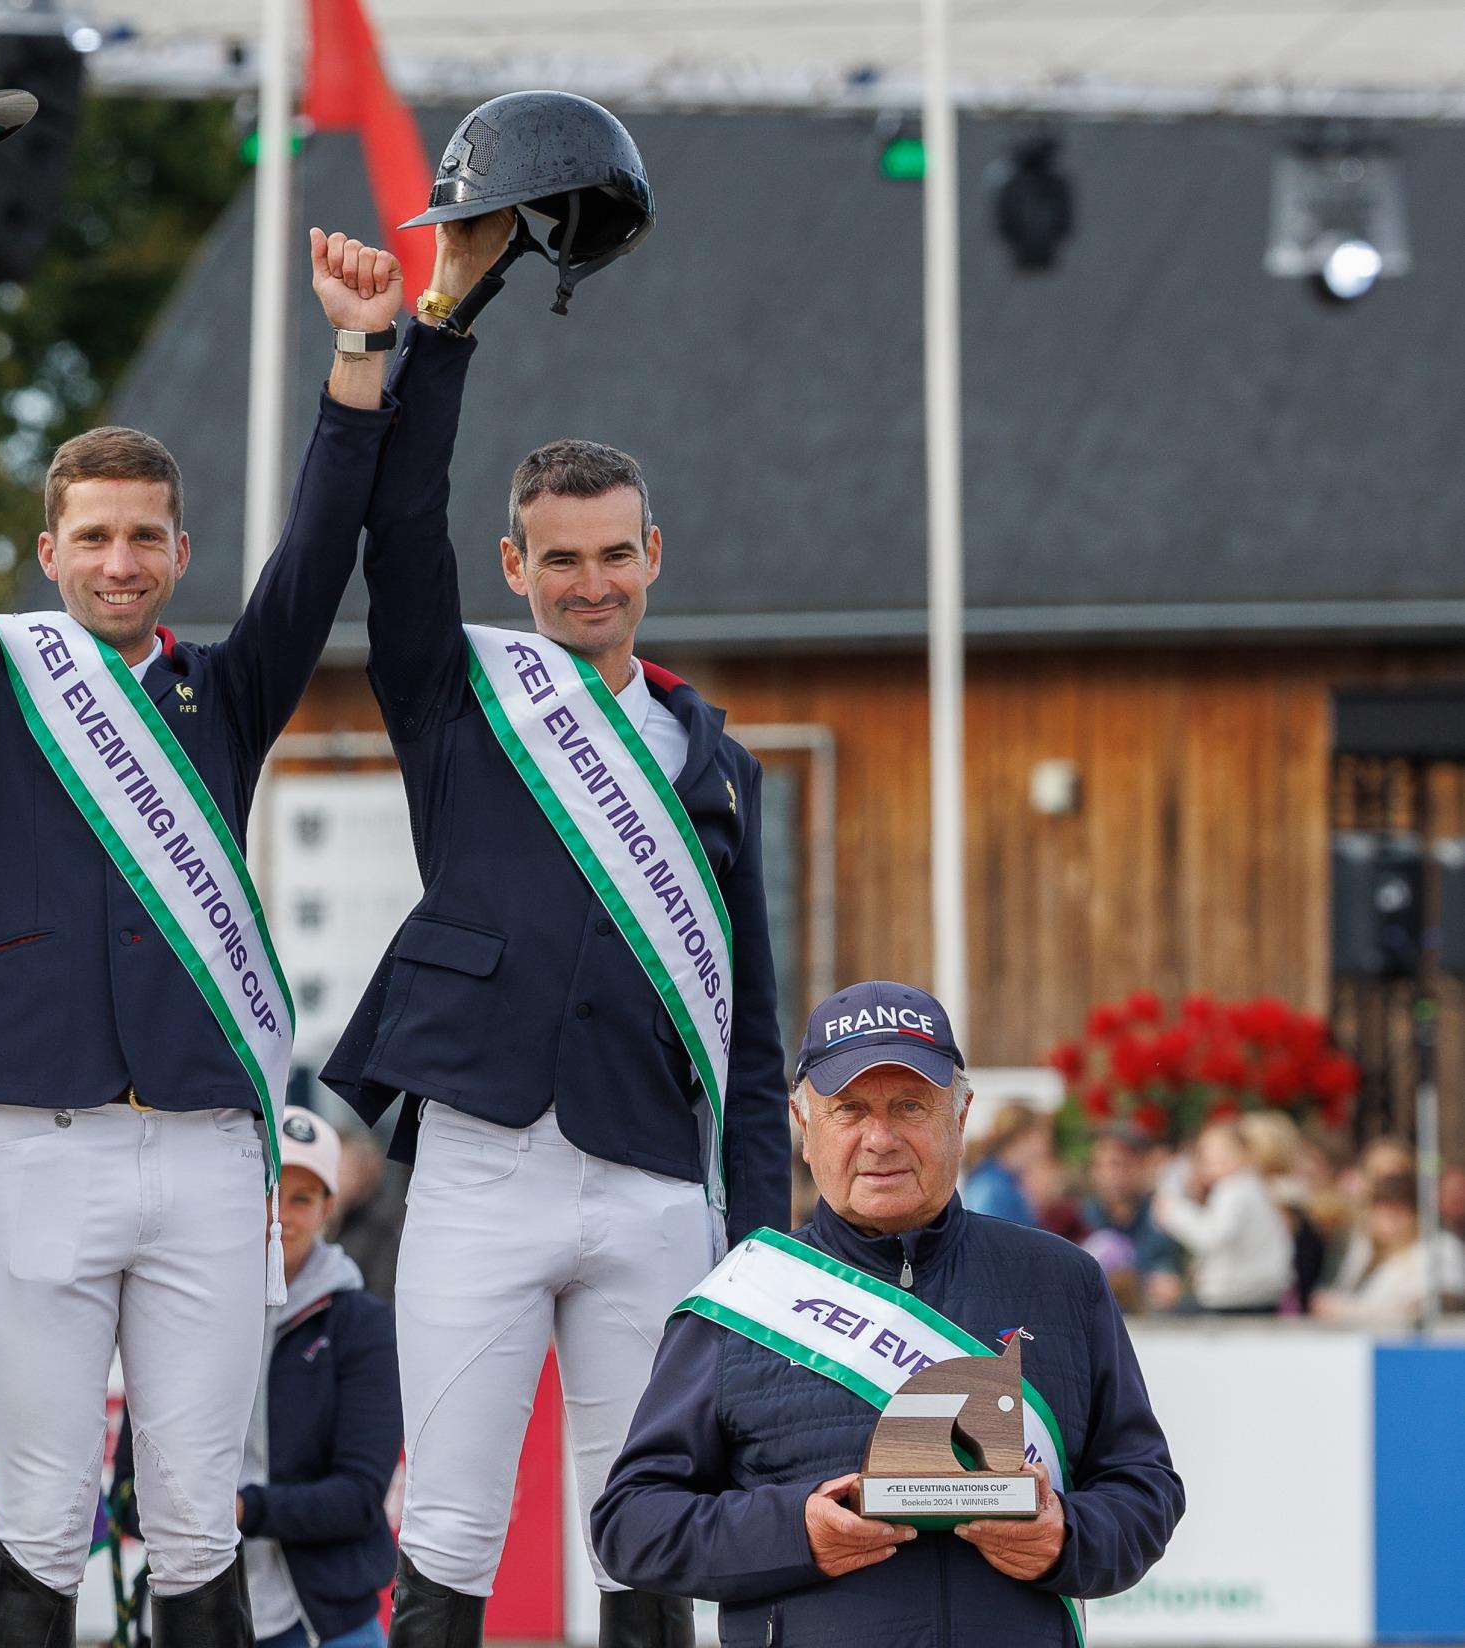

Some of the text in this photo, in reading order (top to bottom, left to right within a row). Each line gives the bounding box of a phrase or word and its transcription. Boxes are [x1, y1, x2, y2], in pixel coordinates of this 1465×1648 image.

[62, 680, 175, 839] EVENTING
[163, 832, 247, 972] NATIONS
[543, 706, 656, 864] EVENTING
[643, 859, 720, 999] NATIONS
[825, 1005, 934, 1041] FRANCE
[908, 1484, 951, 1492] EVENTING
[952, 1484, 989, 1492] NATIONS
[933, 1498, 953, 1506] 2024
[961, 1498, 999, 1506] WINNERS
